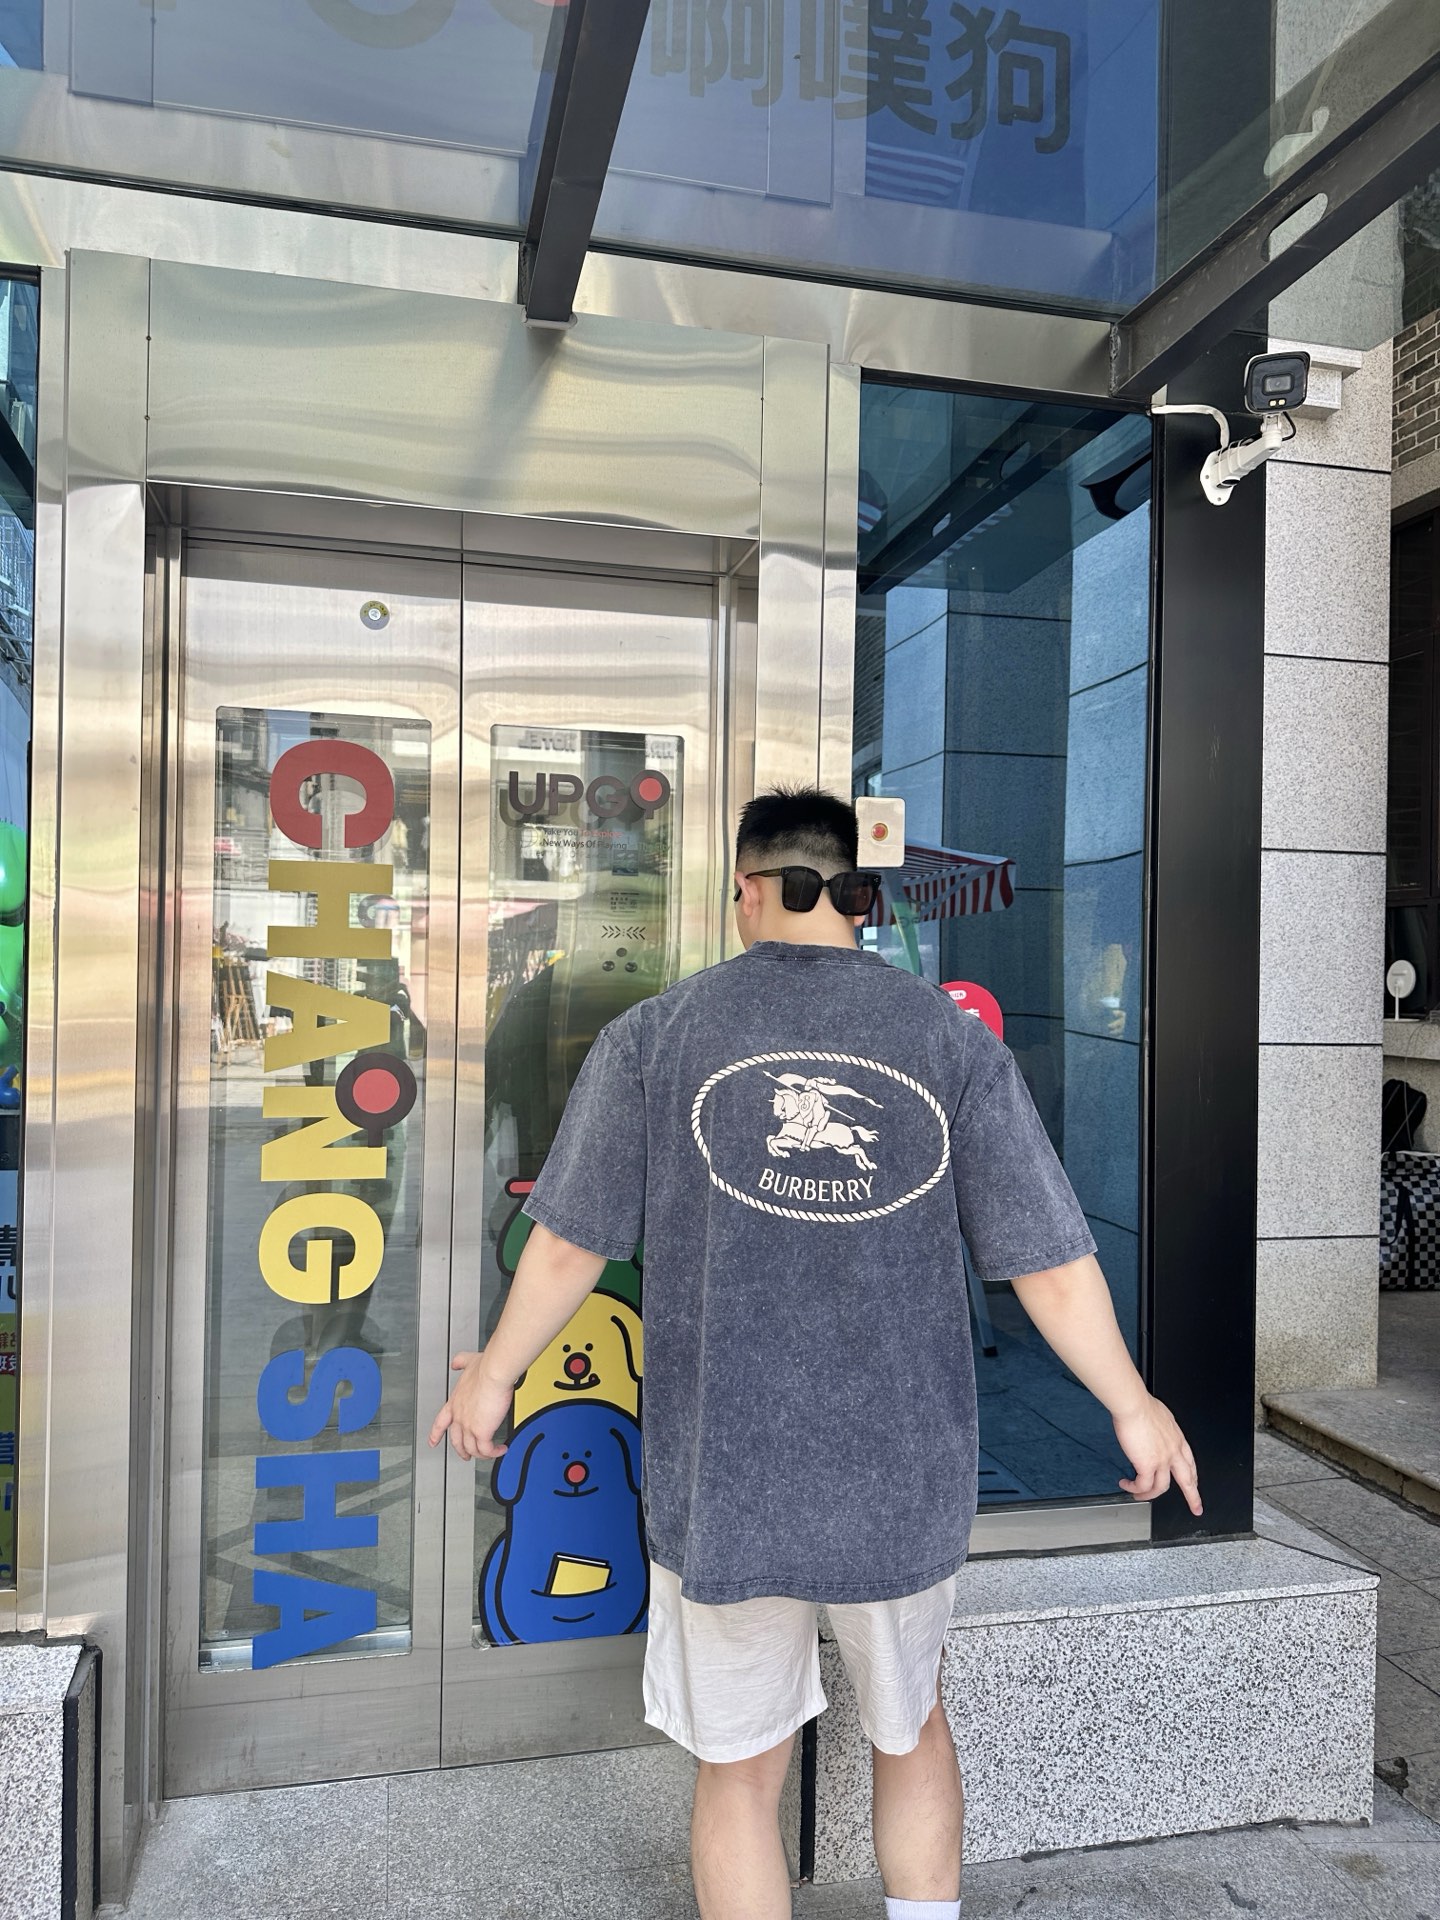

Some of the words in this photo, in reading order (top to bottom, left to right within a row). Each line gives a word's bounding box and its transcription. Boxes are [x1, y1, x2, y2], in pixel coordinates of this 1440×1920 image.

[563, 828, 579, 837] You
[543, 839, 562, 847] New
[563, 839, 585, 850] Ways
[586, 840, 597, 849] Of
[758, 1168, 875, 1202] BURBERRY
